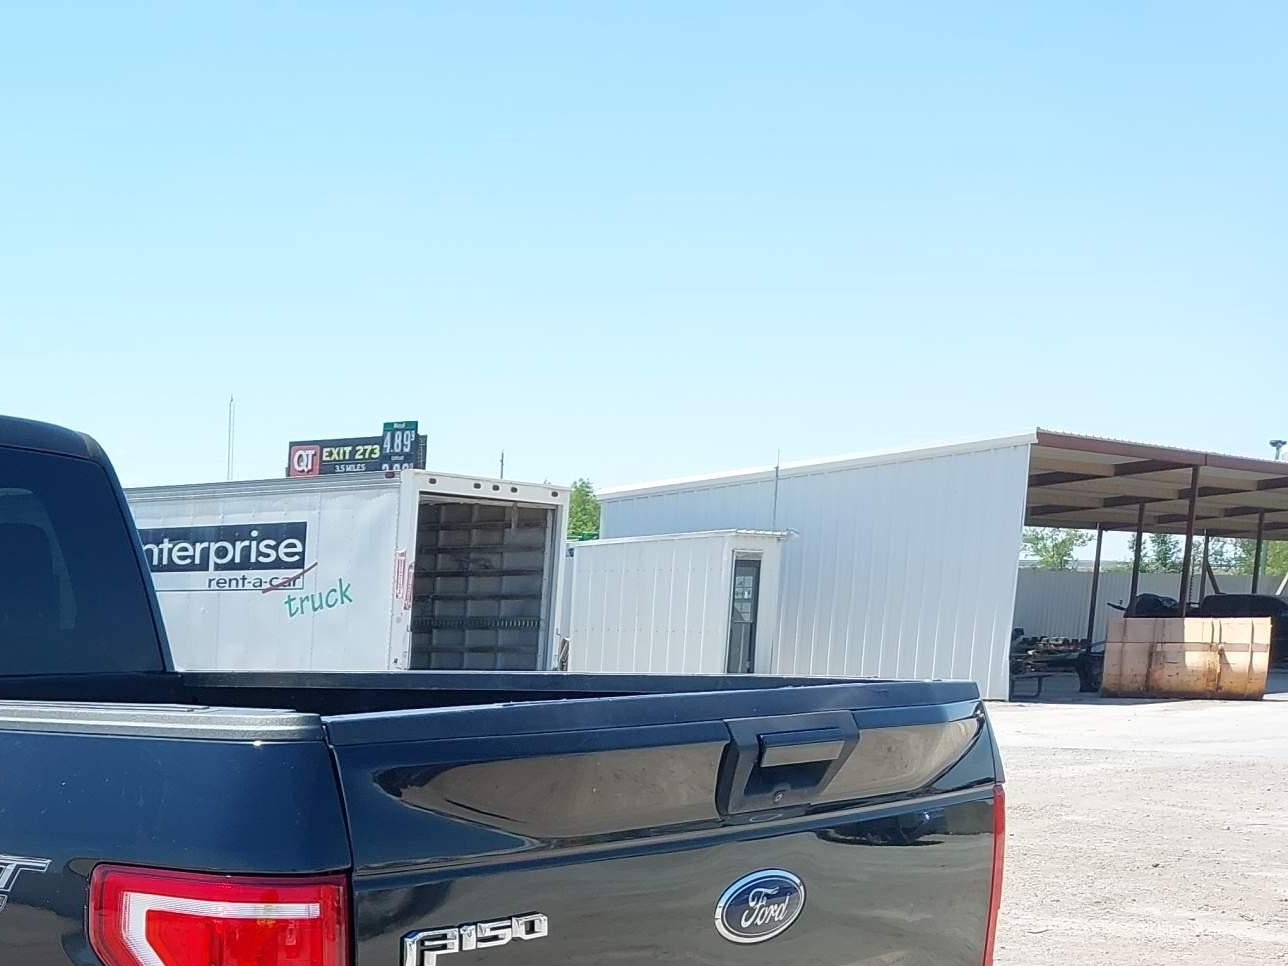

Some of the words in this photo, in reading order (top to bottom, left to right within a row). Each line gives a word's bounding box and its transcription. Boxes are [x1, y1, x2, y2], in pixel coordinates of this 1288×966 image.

[293, 450, 315, 472] QT
[322, 447, 352, 460] EXIT
[355, 445, 380, 459] 273
[346, 463, 366, 472] MILES
[208, 574, 301, 589] rent-a-car
[284, 577, 353, 618] truck
[740, 886, 790, 928] Ford
